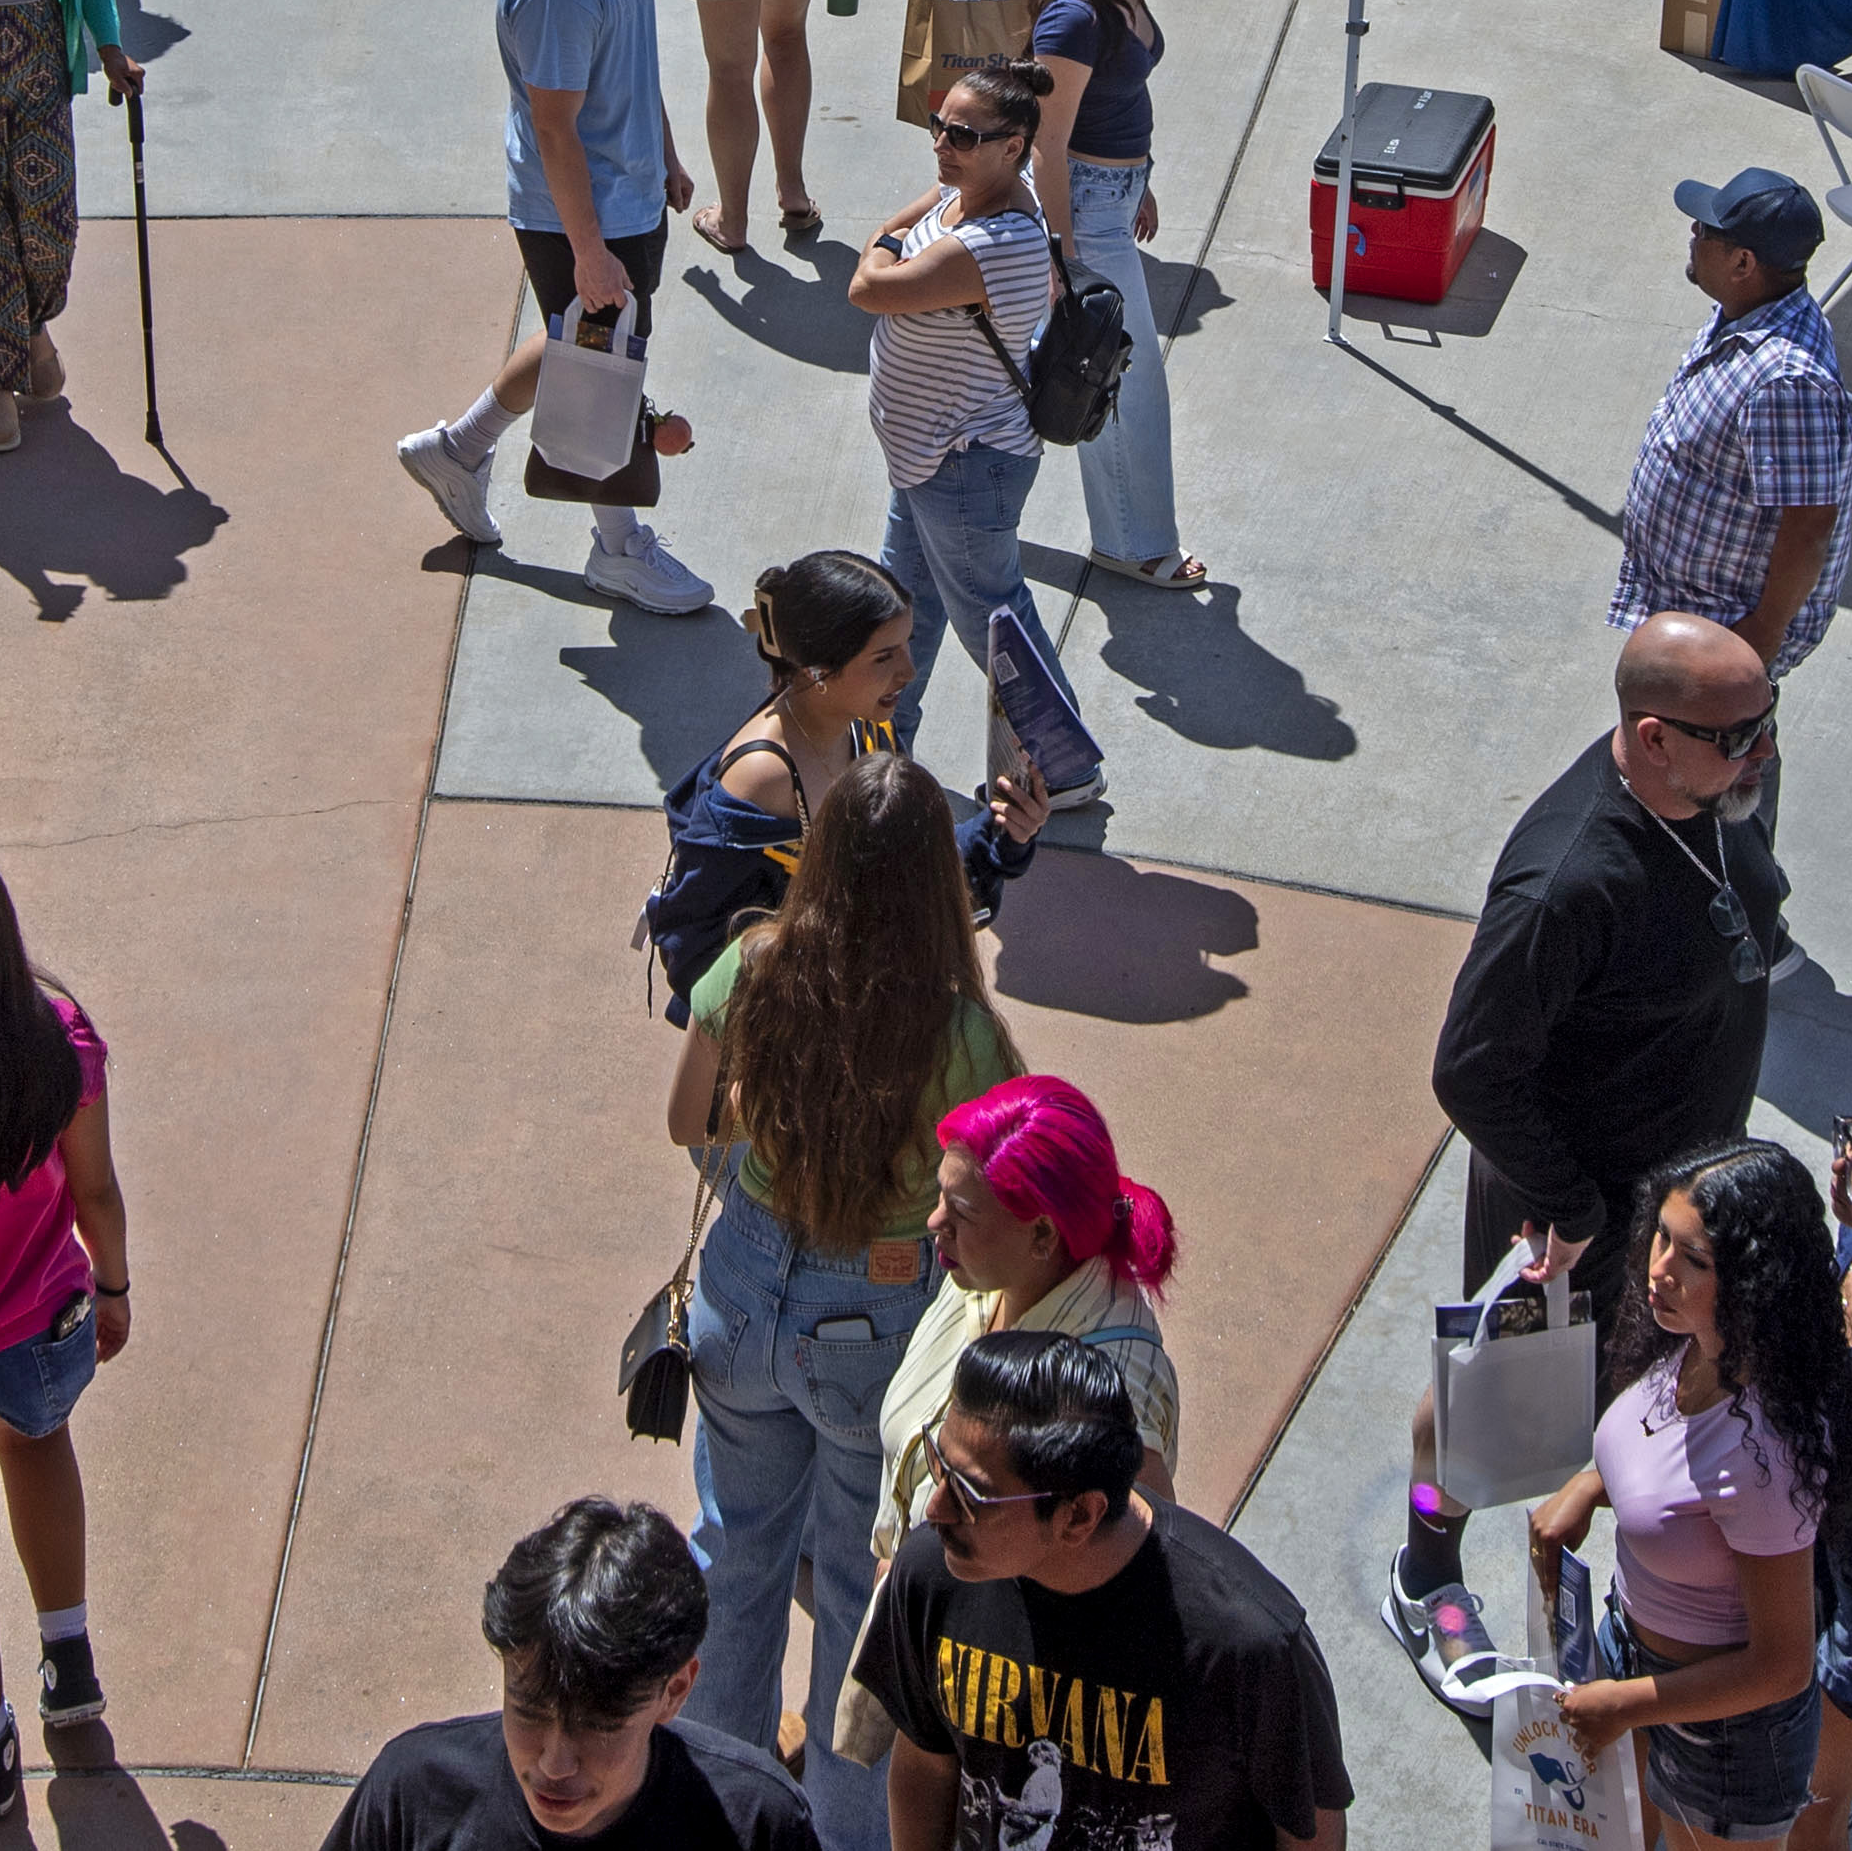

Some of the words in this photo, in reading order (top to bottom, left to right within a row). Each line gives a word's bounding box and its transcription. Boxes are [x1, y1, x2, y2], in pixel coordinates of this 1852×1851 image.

[941, 53, 985, 68] Titan
[938, 1636, 1171, 1785] NIRVANA
[1512, 1720, 1561, 1753] UNLOCK
[1525, 1803, 1568, 1829] TITAN
[1573, 1814, 1599, 1841] ERA
